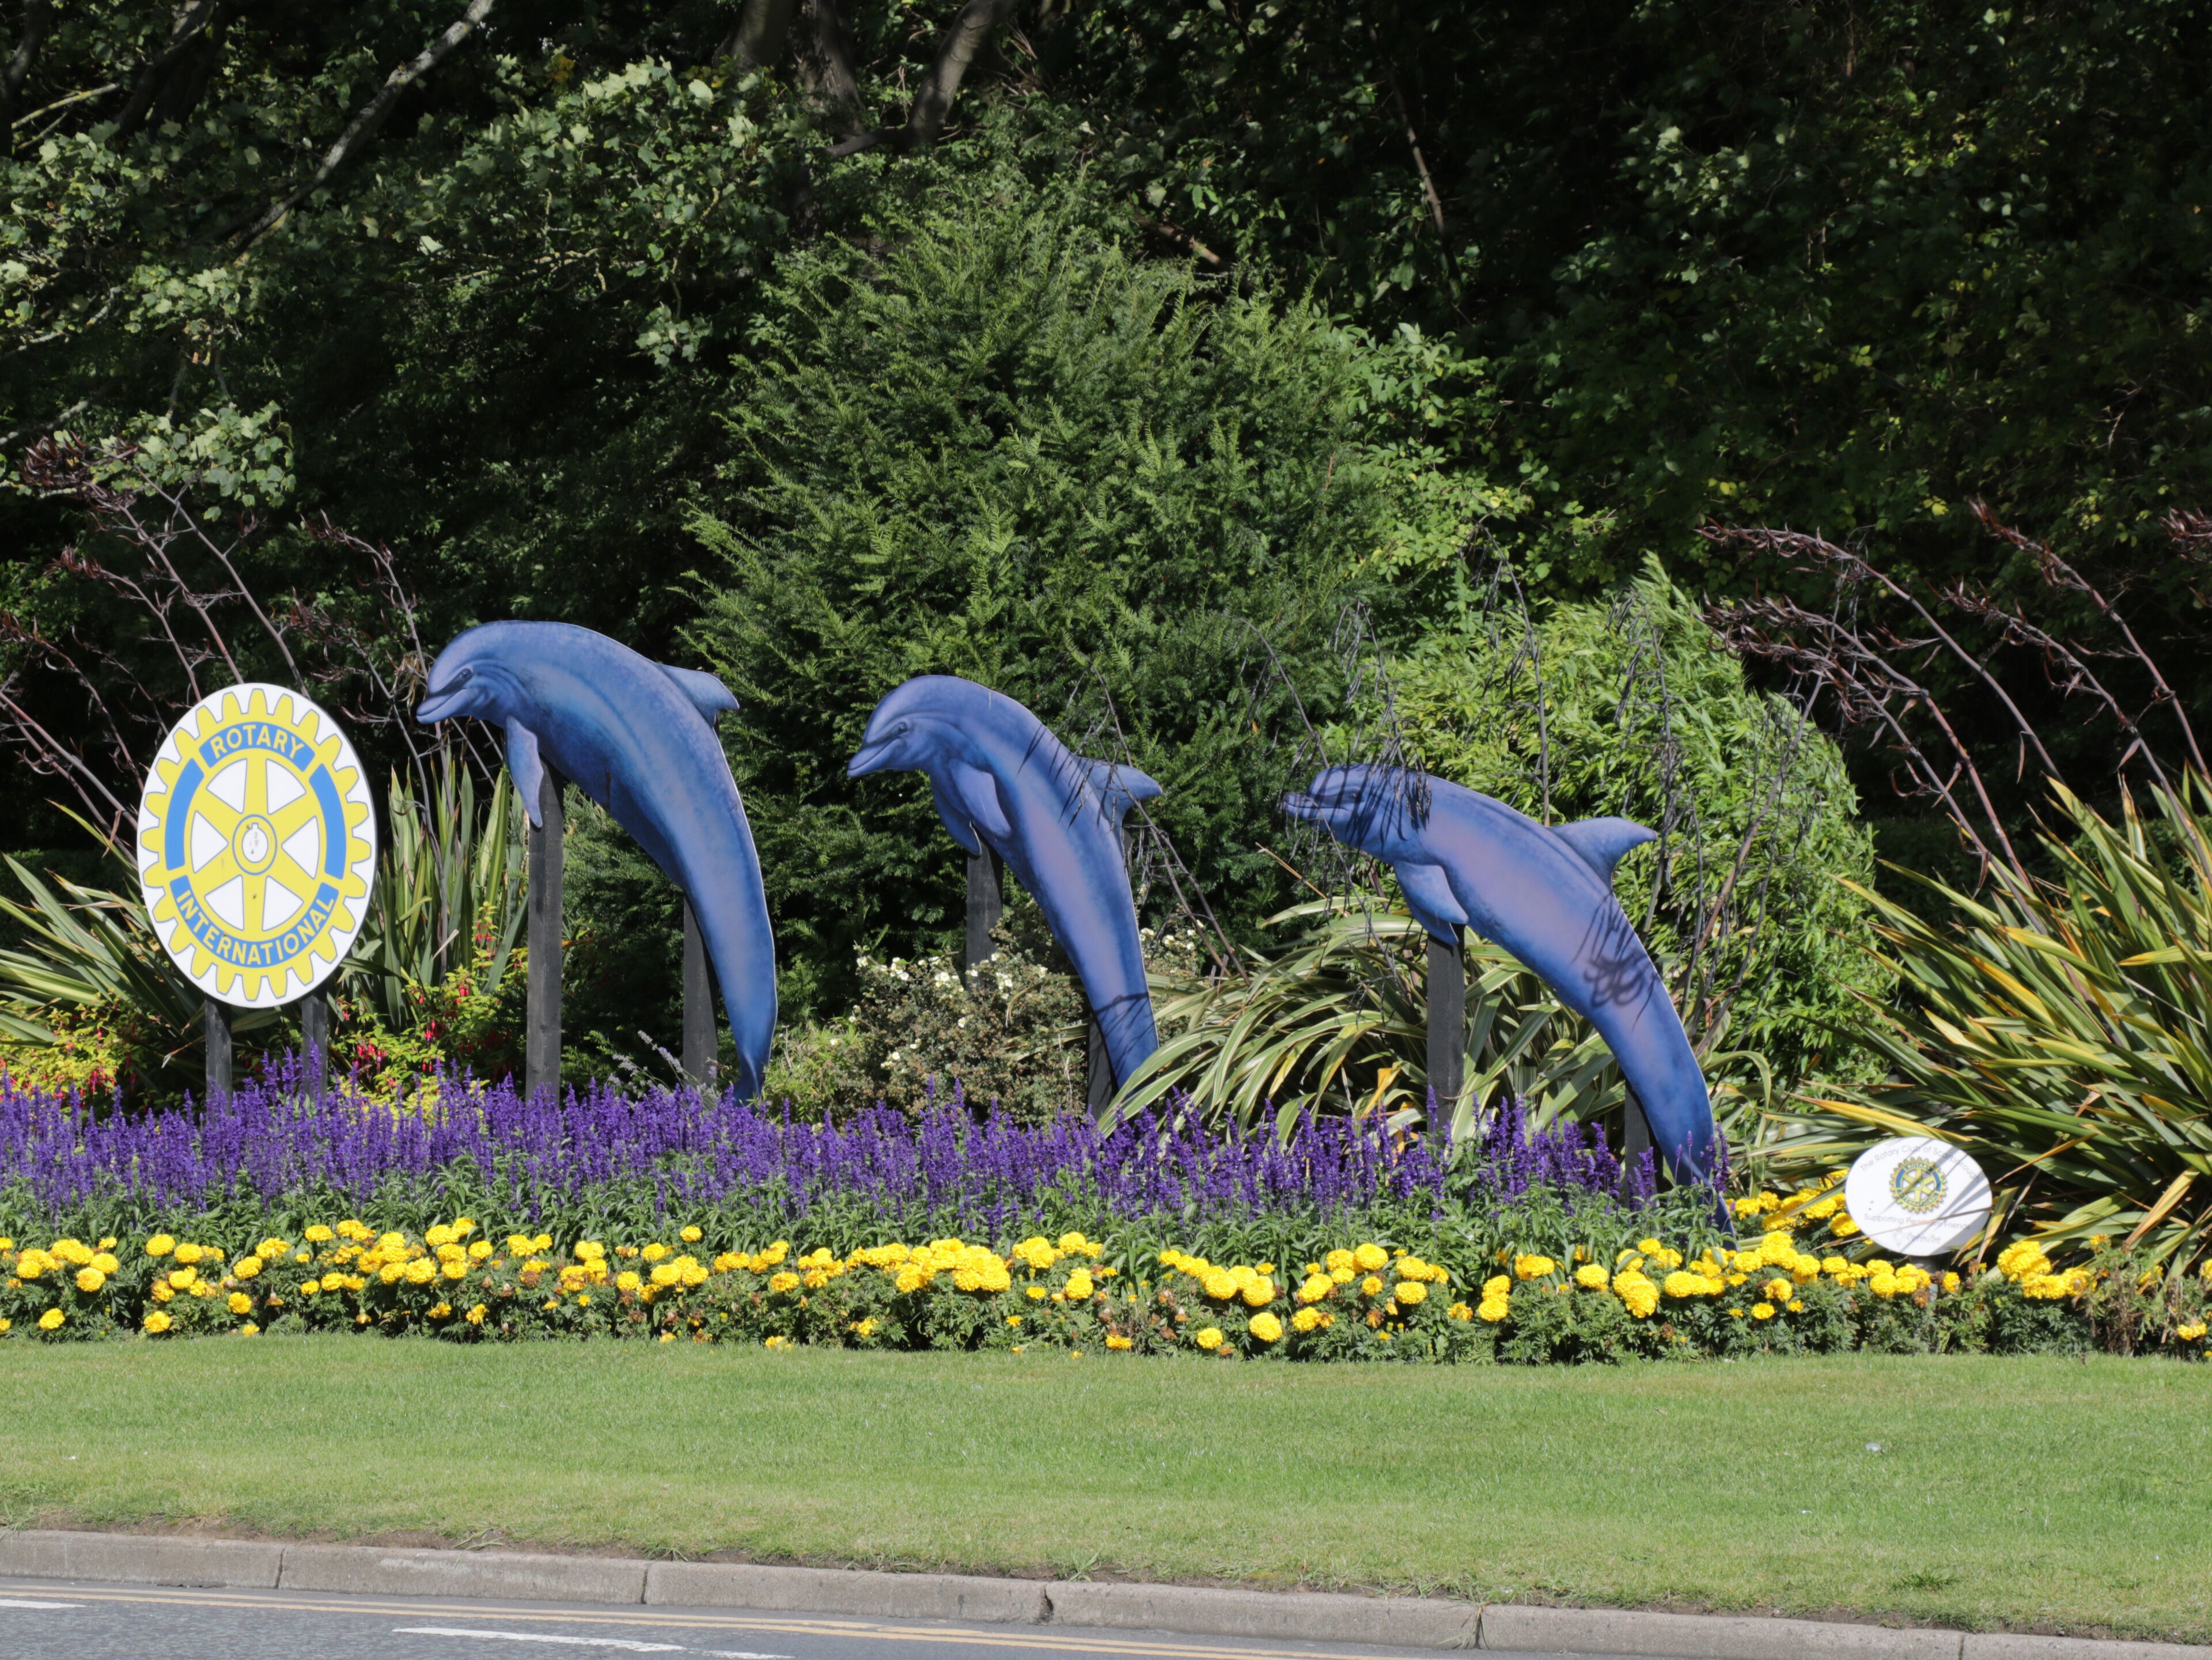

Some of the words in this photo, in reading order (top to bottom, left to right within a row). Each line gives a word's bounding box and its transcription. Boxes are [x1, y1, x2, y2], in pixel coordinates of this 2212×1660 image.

[210, 724, 304, 759] ROTARY
[176, 889, 335, 965] INTERNATIONAL
[1859, 1160, 1875, 1172] The
[1874, 1148, 1900, 1162] Rotary
[1901, 1144, 1921, 1153] Club
[1933, 1147, 1980, 1183] Scarborough
[1907, 1162, 1930, 1170] ROTARY
[1900, 1193, 1937, 1207] TERNATIONAL
[1864, 1213, 1904, 1225] Supporting
[1944, 1221, 1971, 1230] Friends
